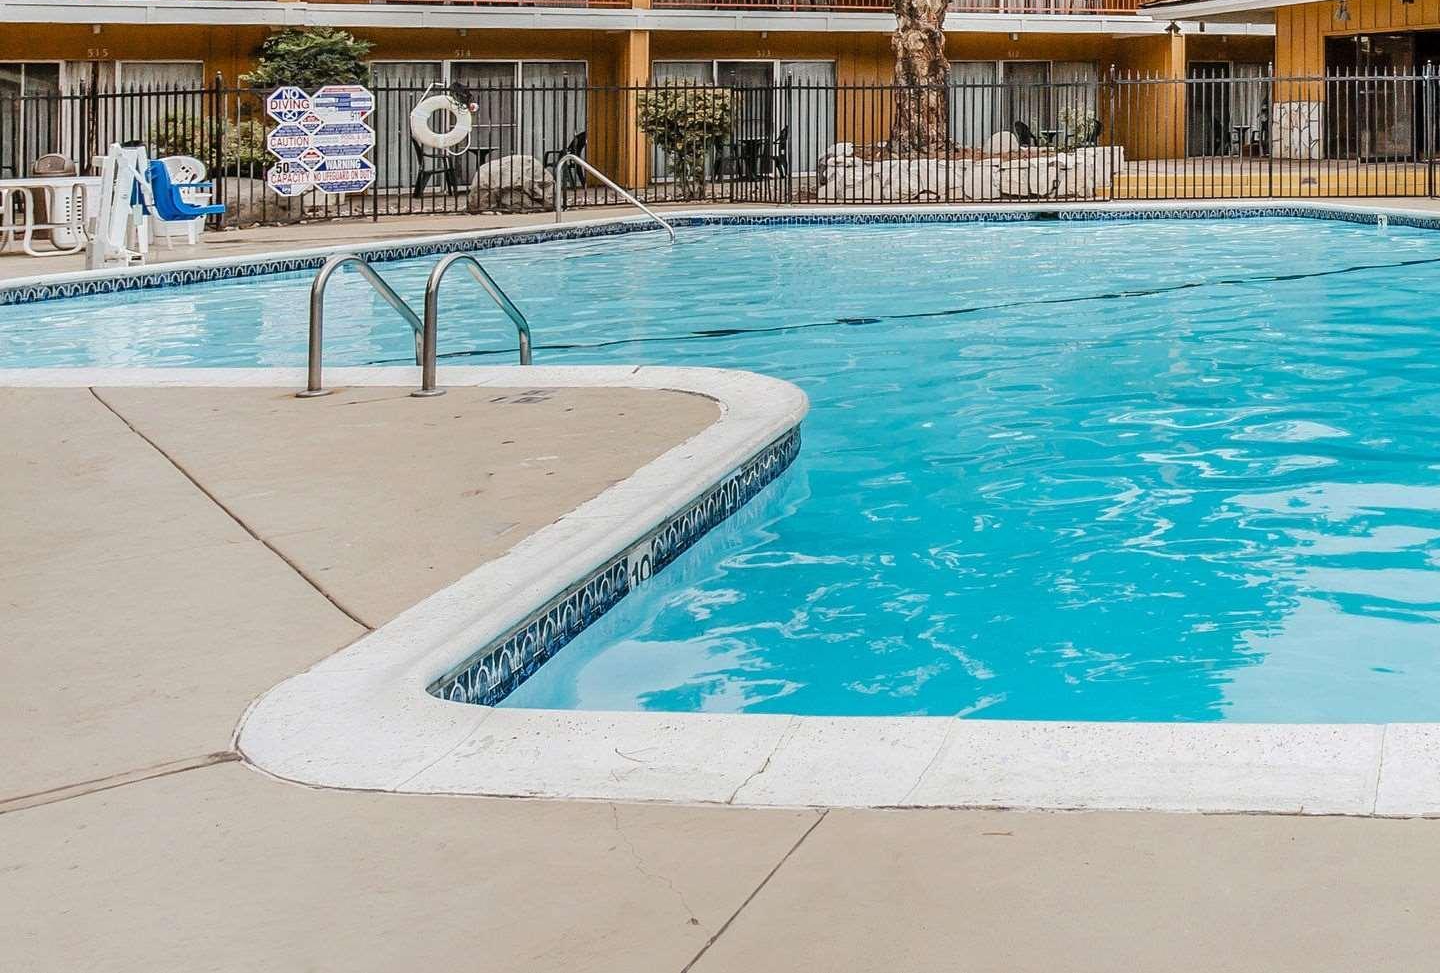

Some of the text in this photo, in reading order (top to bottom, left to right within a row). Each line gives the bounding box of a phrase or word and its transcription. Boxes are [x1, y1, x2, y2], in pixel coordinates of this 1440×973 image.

[282, 90, 299, 99] NO
[270, 100, 310, 110] DIVING
[270, 137, 309, 147] CAUTION
[276, 162, 290, 174] 50
[325, 159, 361, 170] WARNING
[271, 172, 310, 184] CAPACITY
[322, 171, 350, 181] LIFEGUARD
[632, 554, 651, 586] 10
